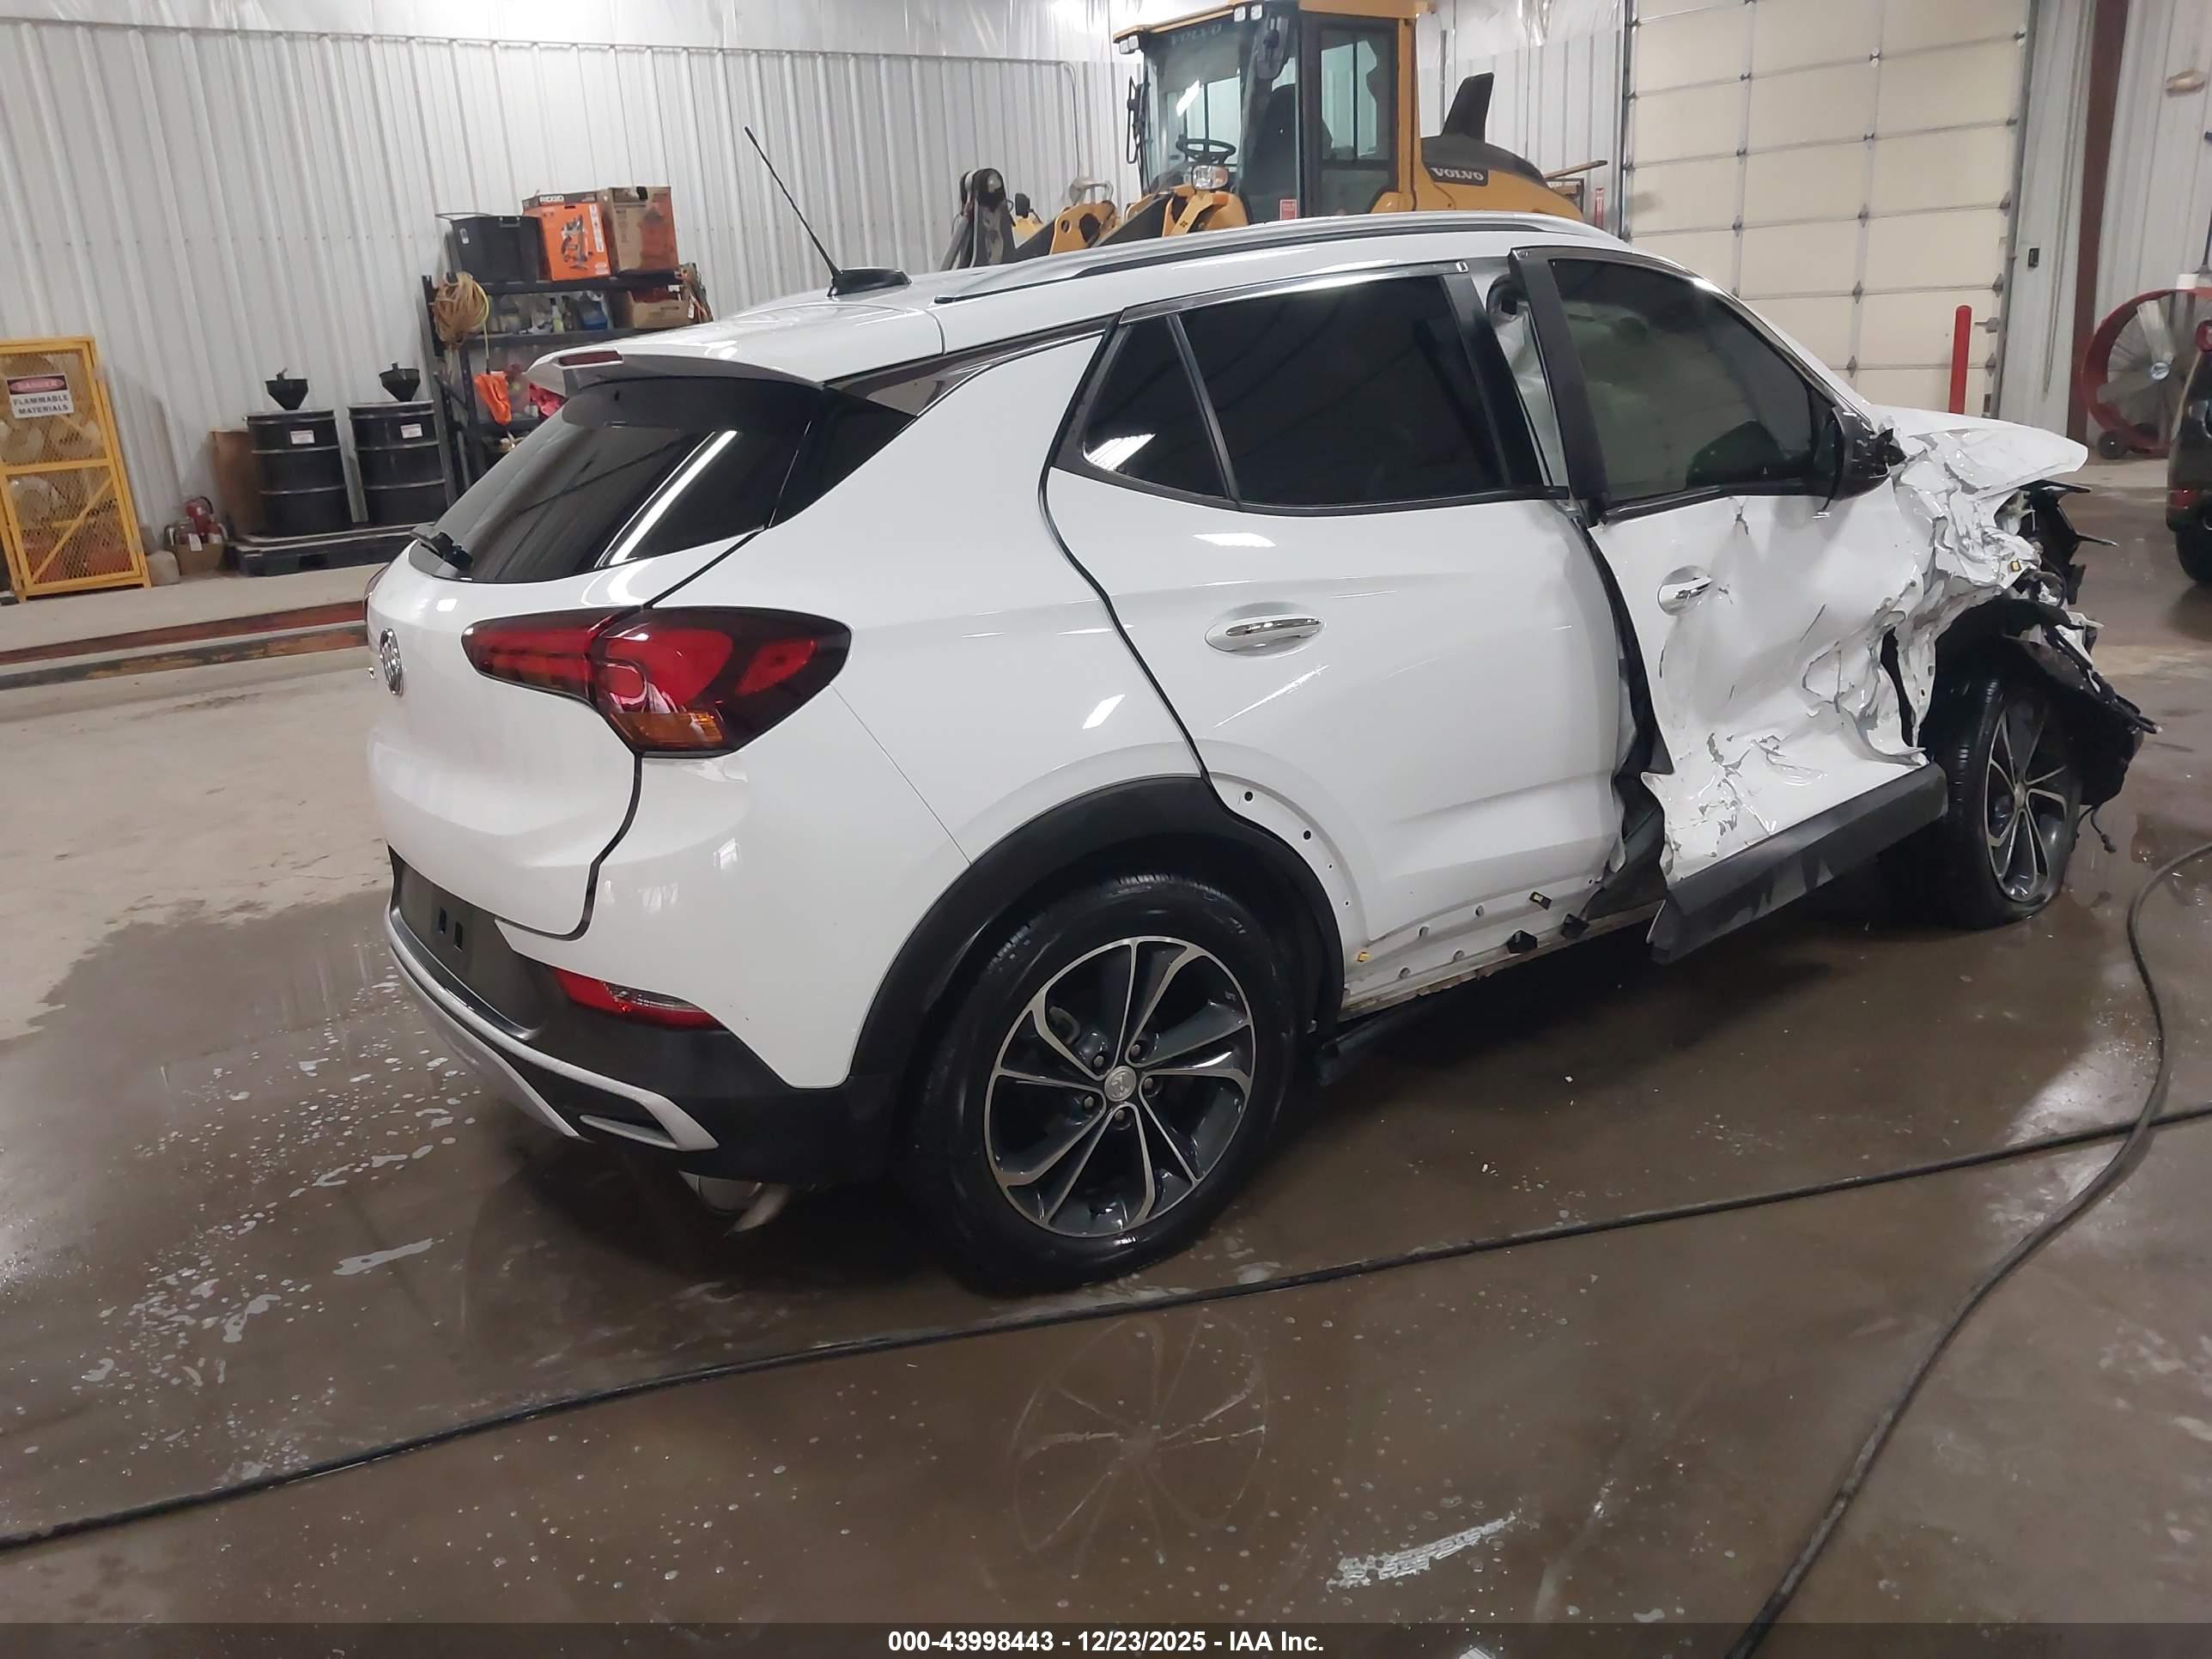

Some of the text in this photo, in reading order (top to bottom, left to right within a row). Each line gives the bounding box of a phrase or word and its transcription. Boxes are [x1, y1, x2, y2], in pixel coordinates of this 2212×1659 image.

[1430, 167, 1484, 181] VOLVO
[14, 395, 68, 405] FLAMMABLE
[19, 404, 69, 414] MATERIALS
